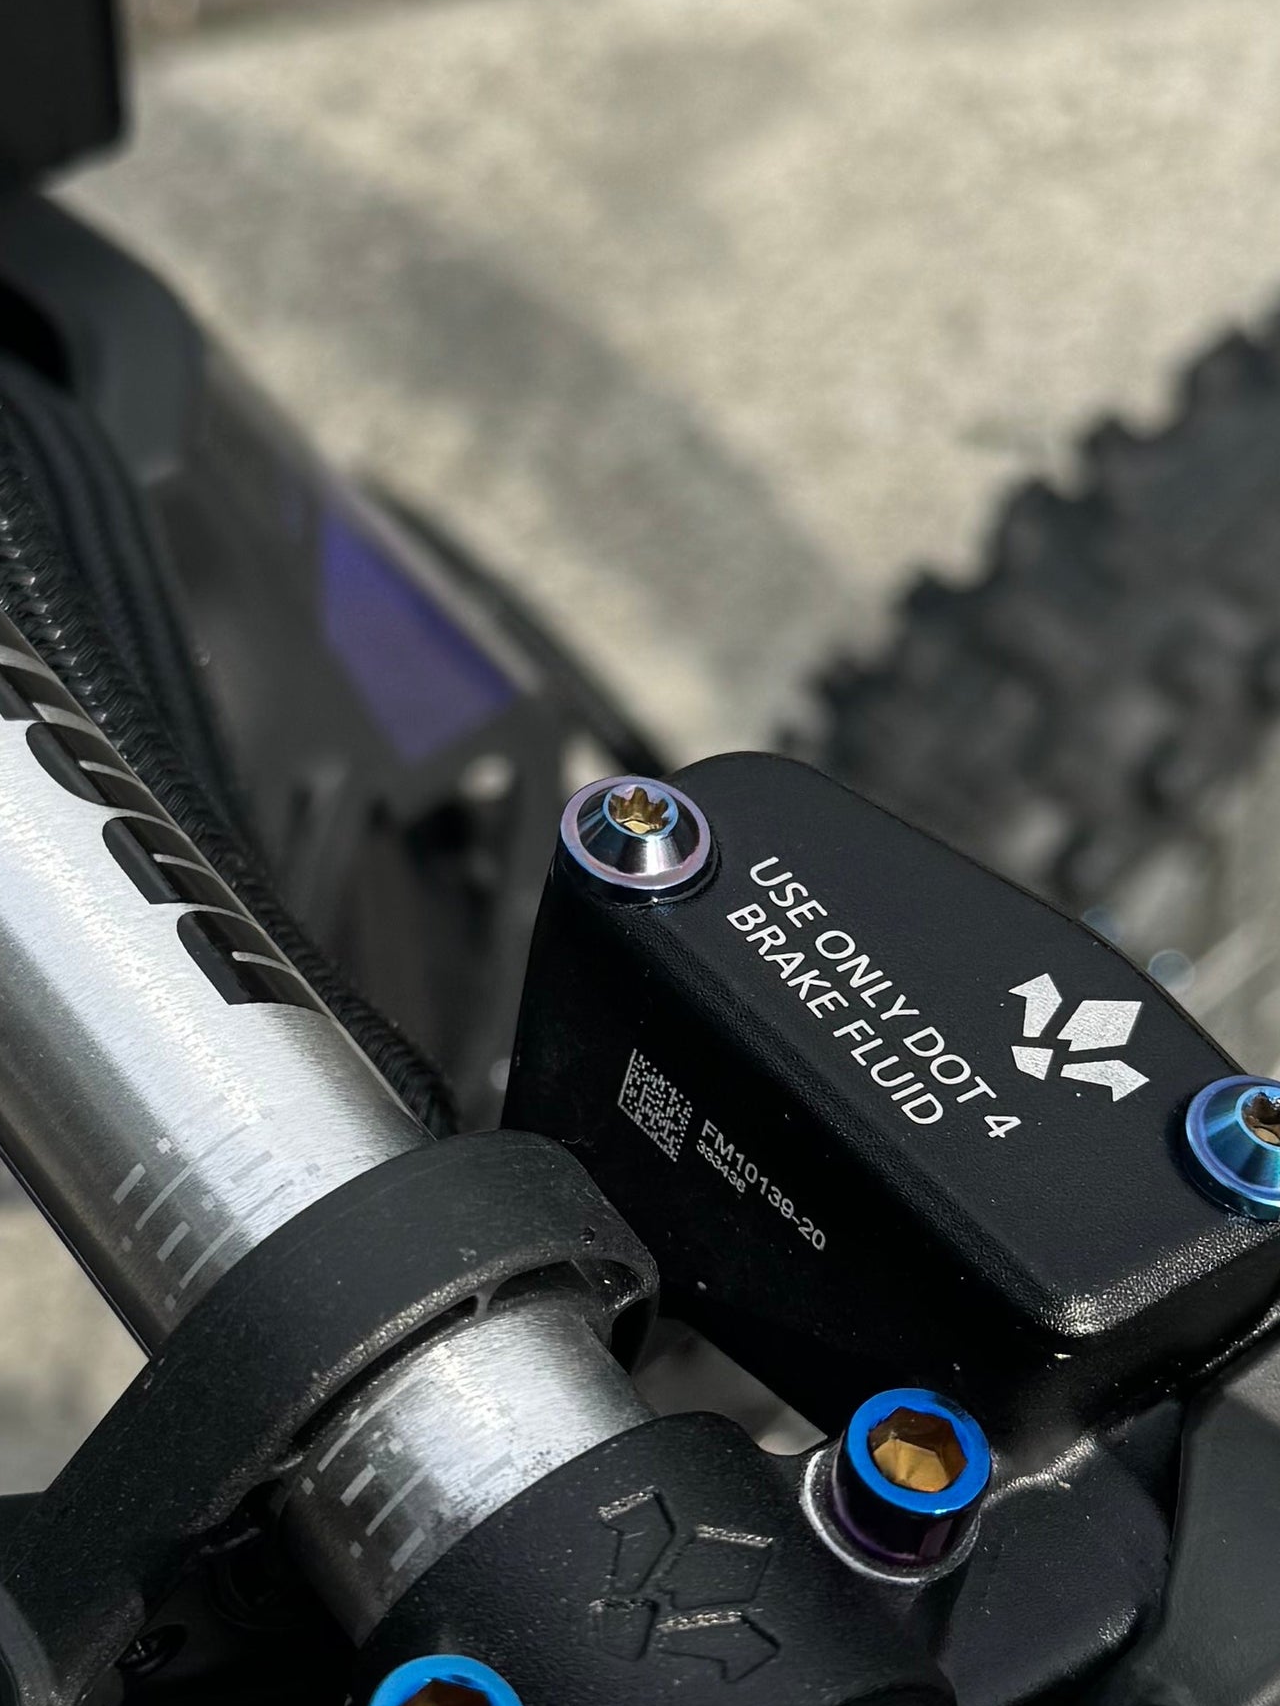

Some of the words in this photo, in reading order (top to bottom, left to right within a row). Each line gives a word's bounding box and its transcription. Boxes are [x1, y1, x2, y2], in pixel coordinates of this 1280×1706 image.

[726, 903, 850, 1019] BRAKE
[832, 1019, 944, 1125] FLUID
[749, 856, 828, 929] USE
[814, 930, 920, 1021] ONLY
[902, 1026, 997, 1104] DOT
[984, 1114, 1022, 1139] 4
[700, 1118, 827, 1251] FM10139-20
